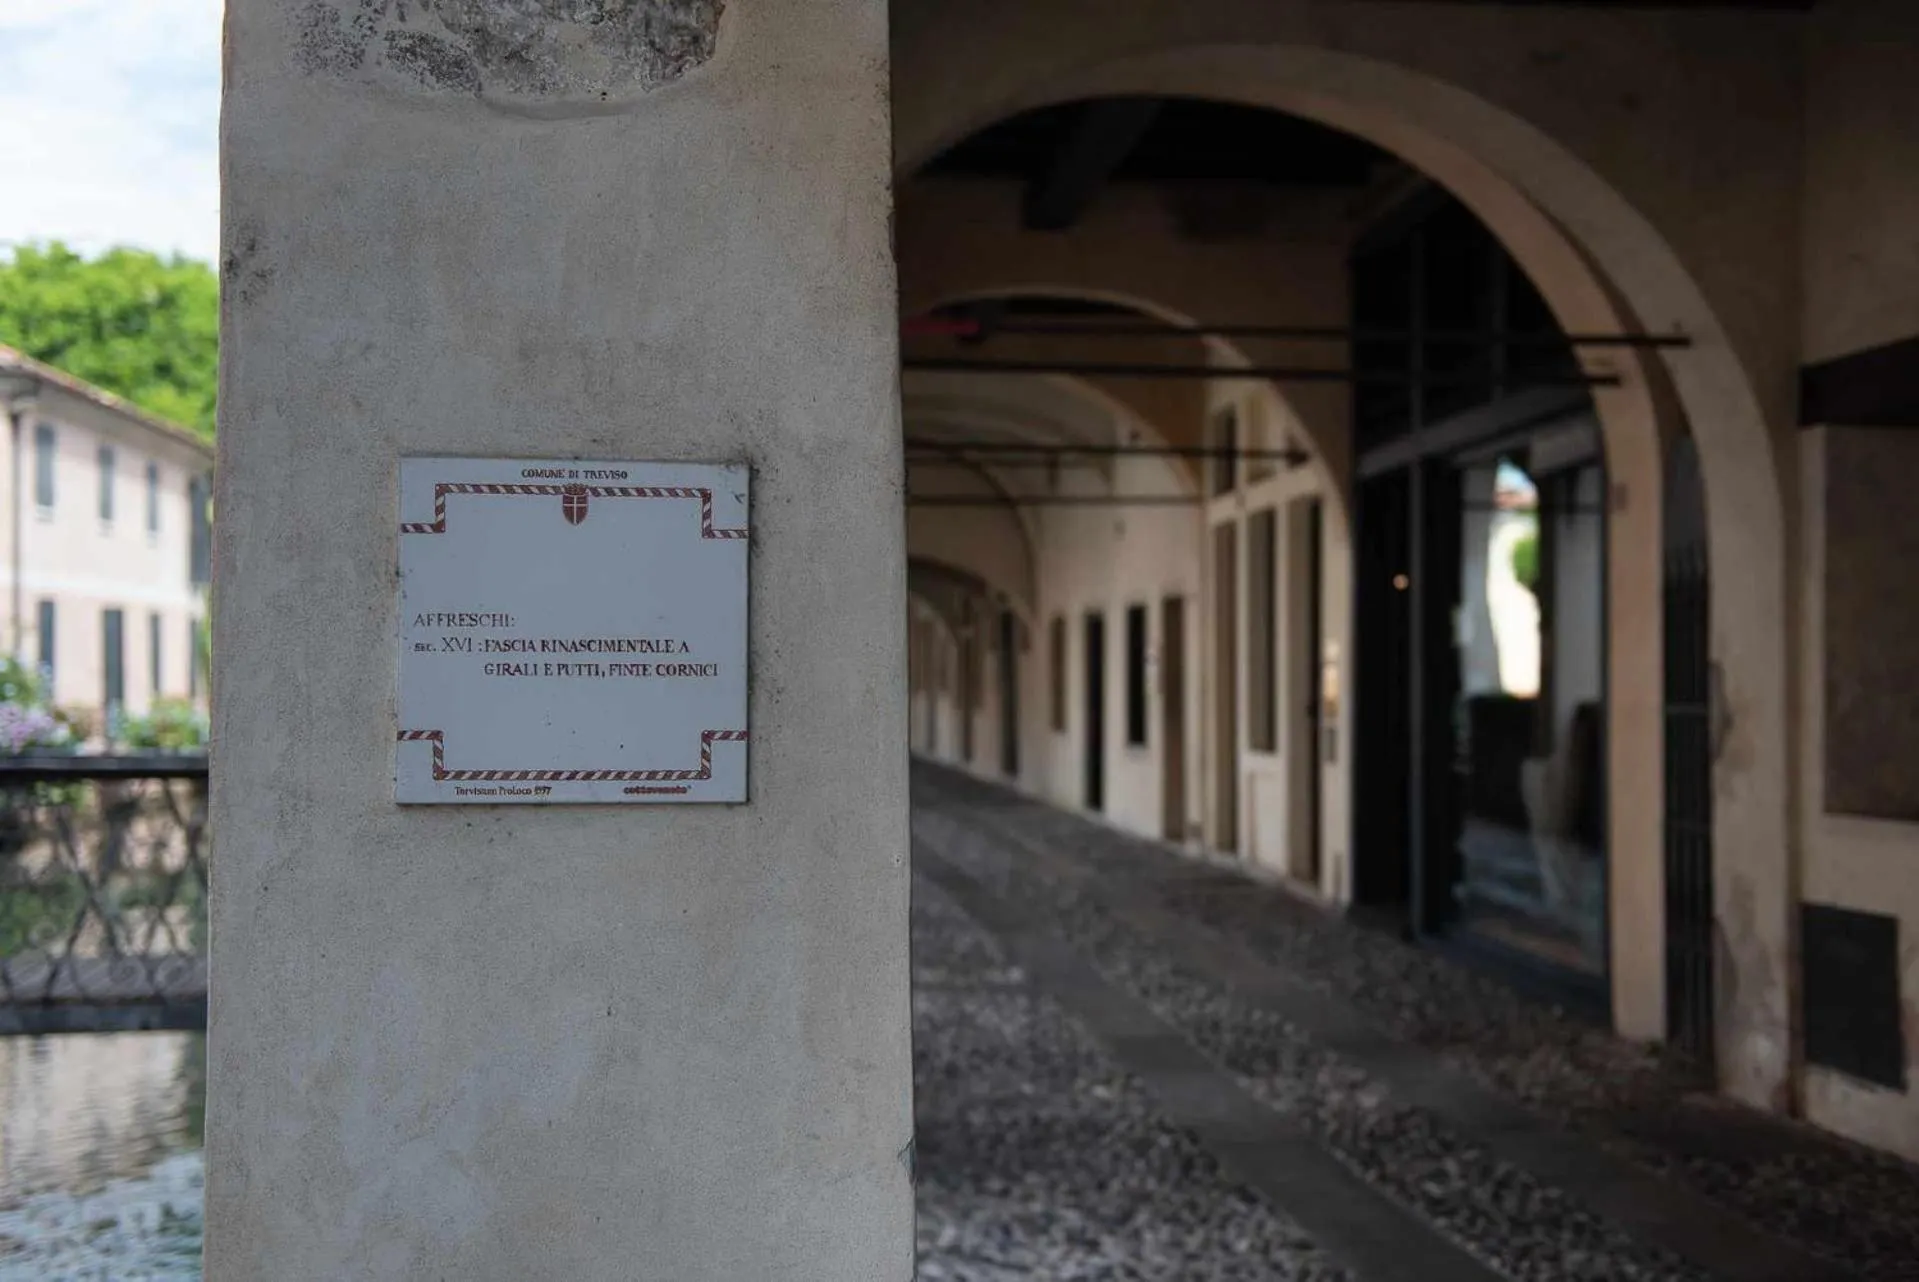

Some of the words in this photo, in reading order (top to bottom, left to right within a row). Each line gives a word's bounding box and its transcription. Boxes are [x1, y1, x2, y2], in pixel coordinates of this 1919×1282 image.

[521, 469, 565, 478] COMUNE
[568, 470, 579, 479] DI
[583, 470, 628, 480] TREVISO
[413, 613, 515, 627] AFFRESCHI:
[442, 637, 472, 652] XVI
[540, 639, 674, 653] RINASCIMENTALE
[679, 639, 690, 653] A
[484, 663, 538, 676] GIRALI
[544, 663, 554, 676] E
[557, 663, 606, 678] PUTTI,
[609, 663, 652, 676] FINTE
[655, 663, 718, 677] CORNICI
